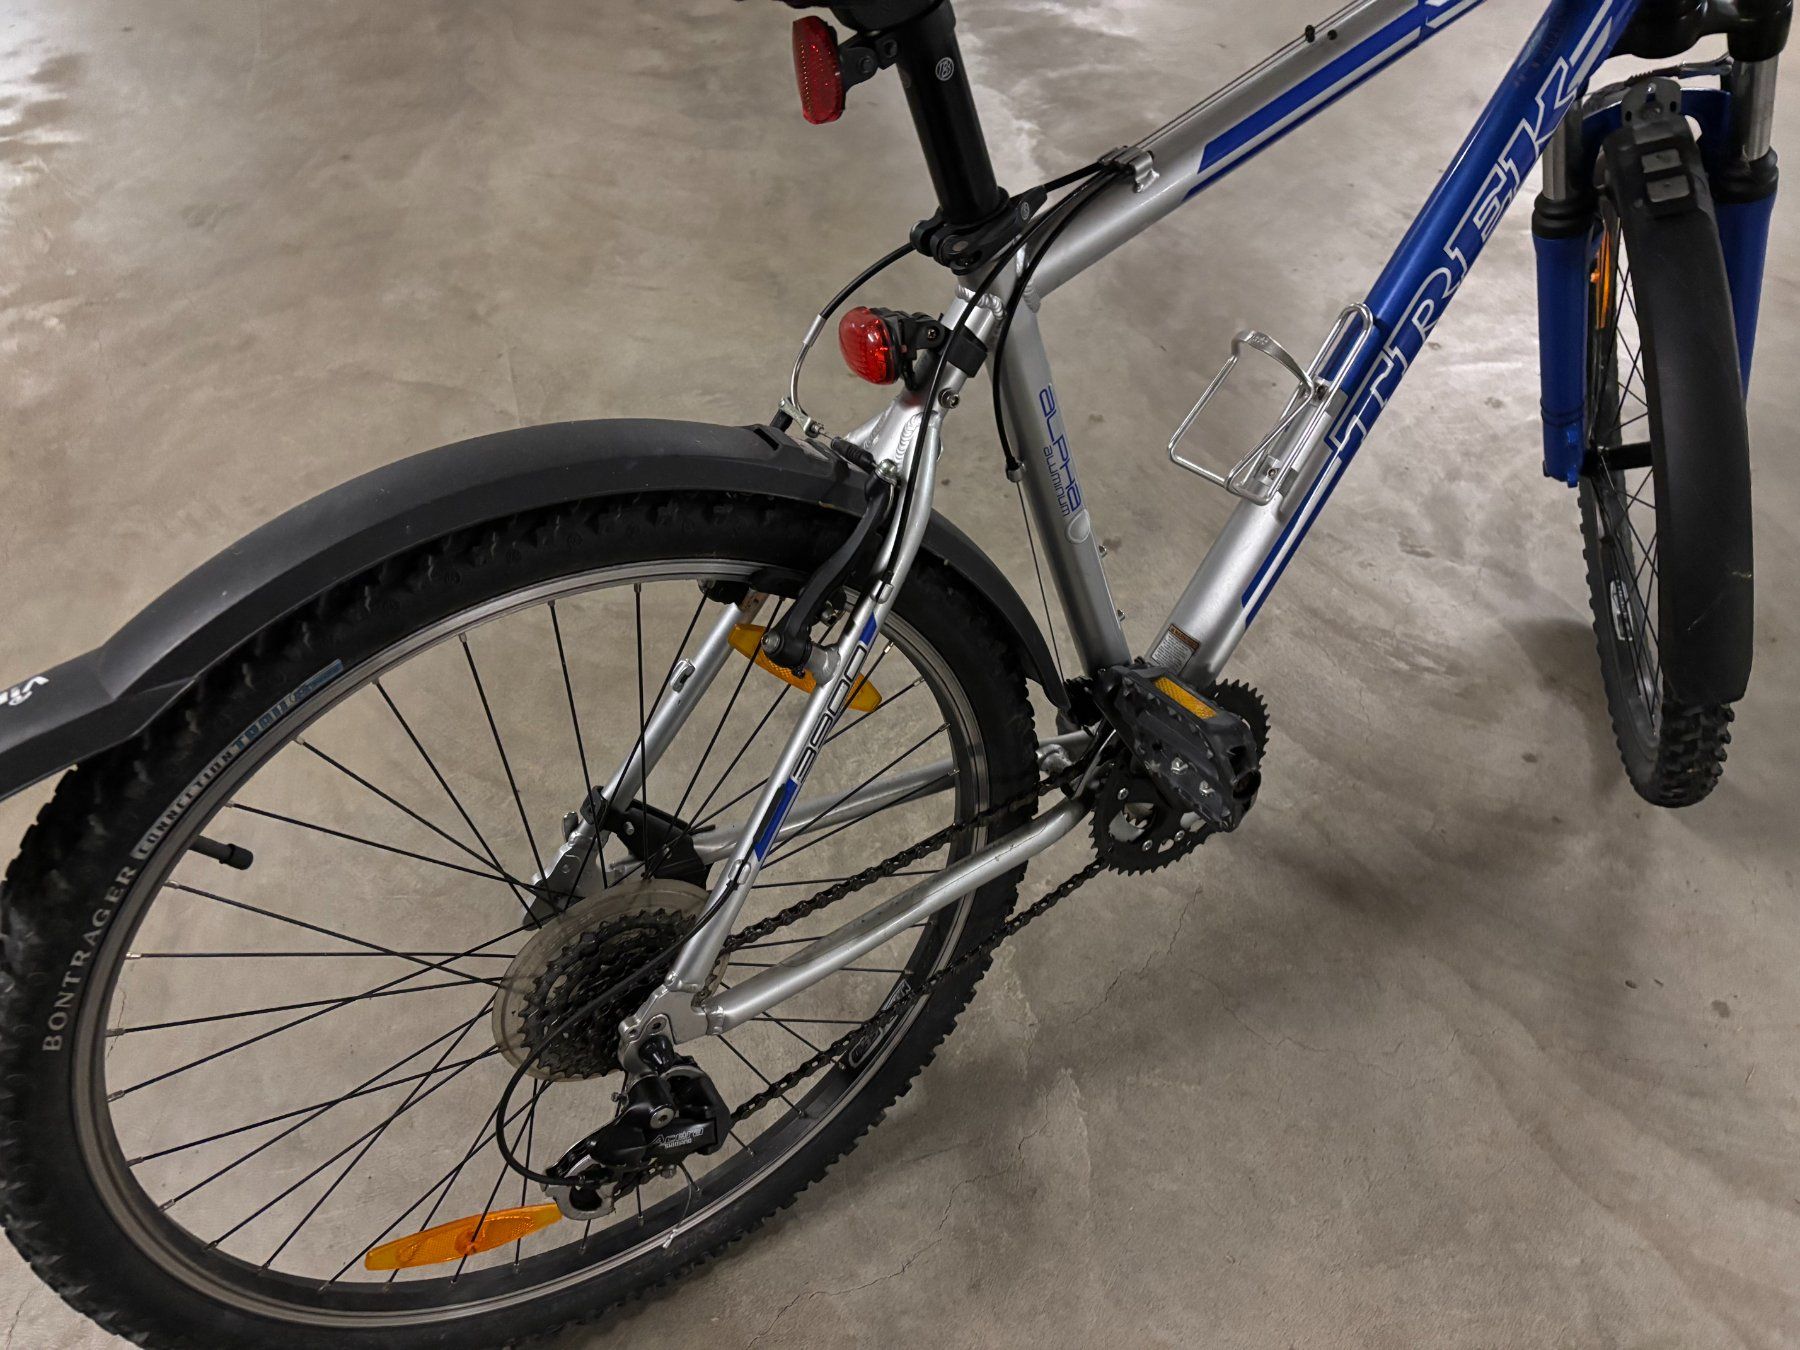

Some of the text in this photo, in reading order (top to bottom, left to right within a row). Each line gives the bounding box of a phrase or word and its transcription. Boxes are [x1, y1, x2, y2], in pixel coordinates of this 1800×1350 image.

[1328, 56, 1578, 452] TREK
[792, 644, 867, 784] 3900
[42, 866, 137, 1052] BONTRAGER
